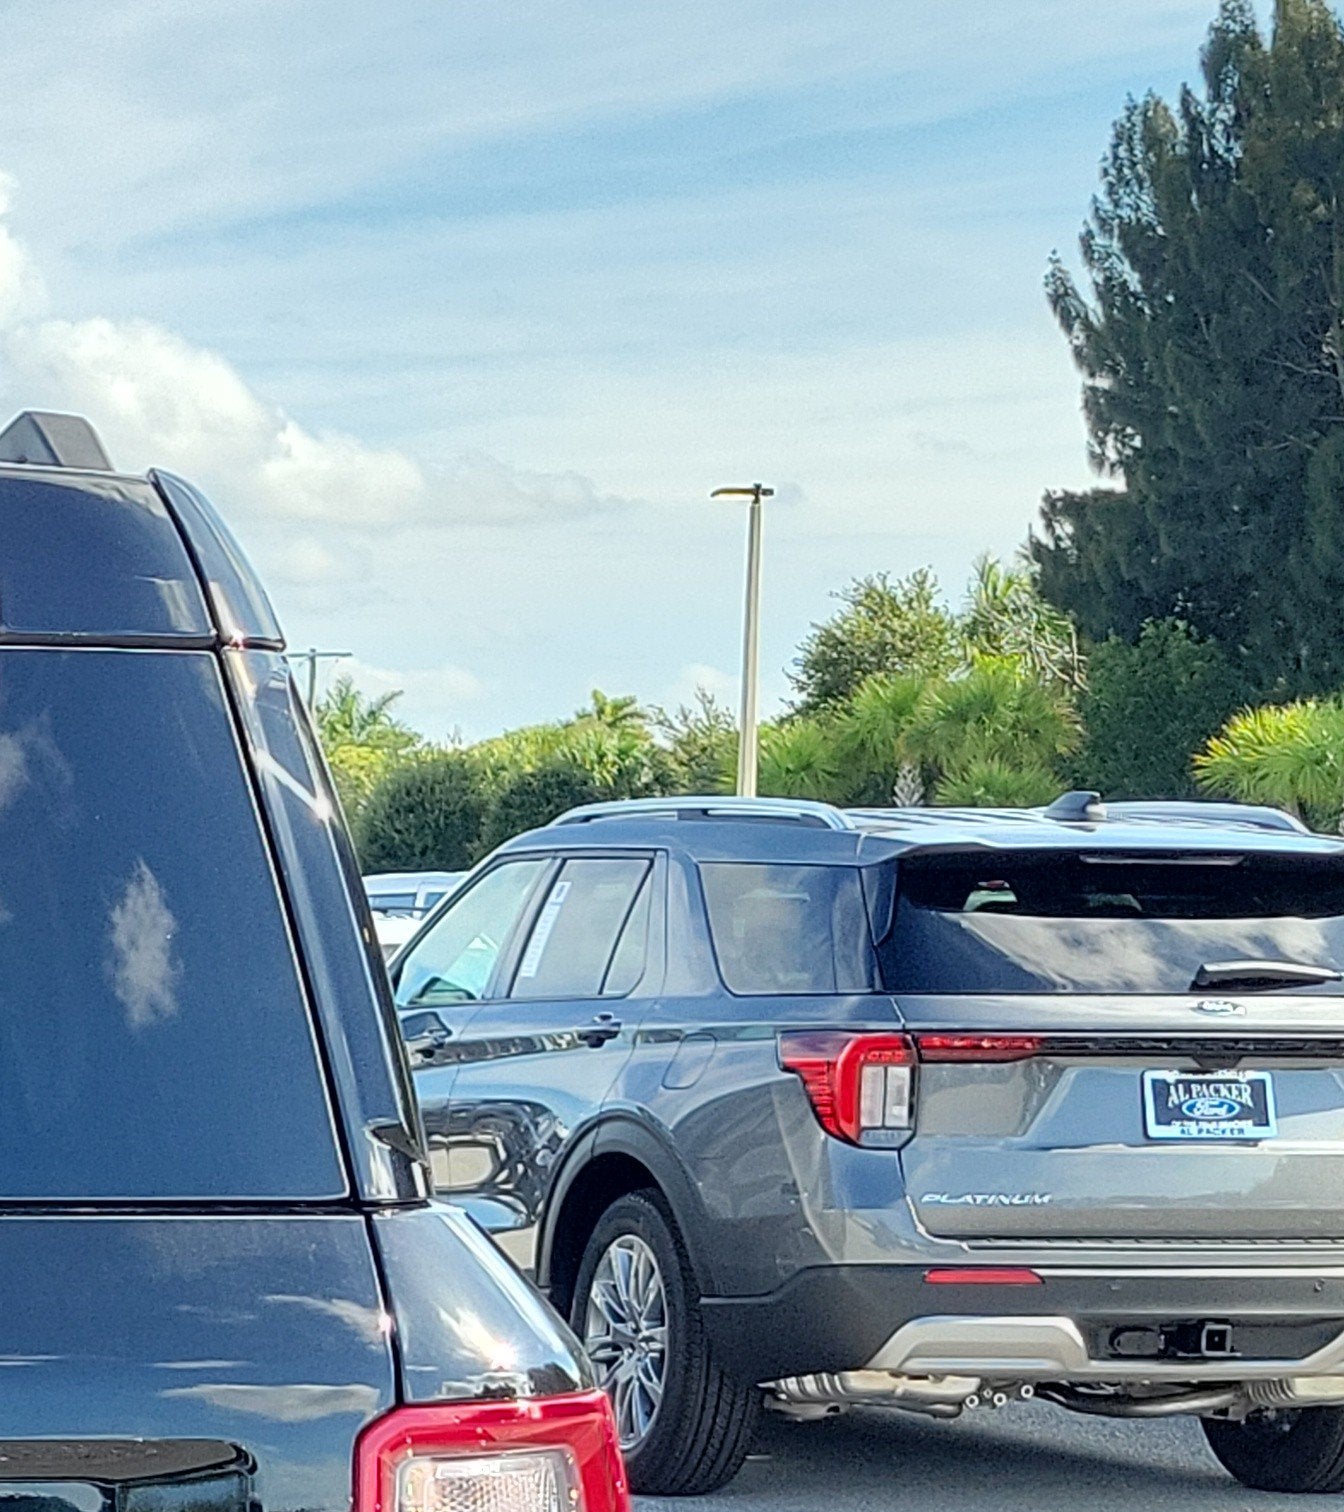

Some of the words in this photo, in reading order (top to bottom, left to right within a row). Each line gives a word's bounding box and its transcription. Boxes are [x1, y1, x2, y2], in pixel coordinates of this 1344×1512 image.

[1168, 1083, 1189, 1108] AL
[1191, 1083, 1254, 1108] PACKER
[921, 1193, 1053, 1205] PLATINUM
